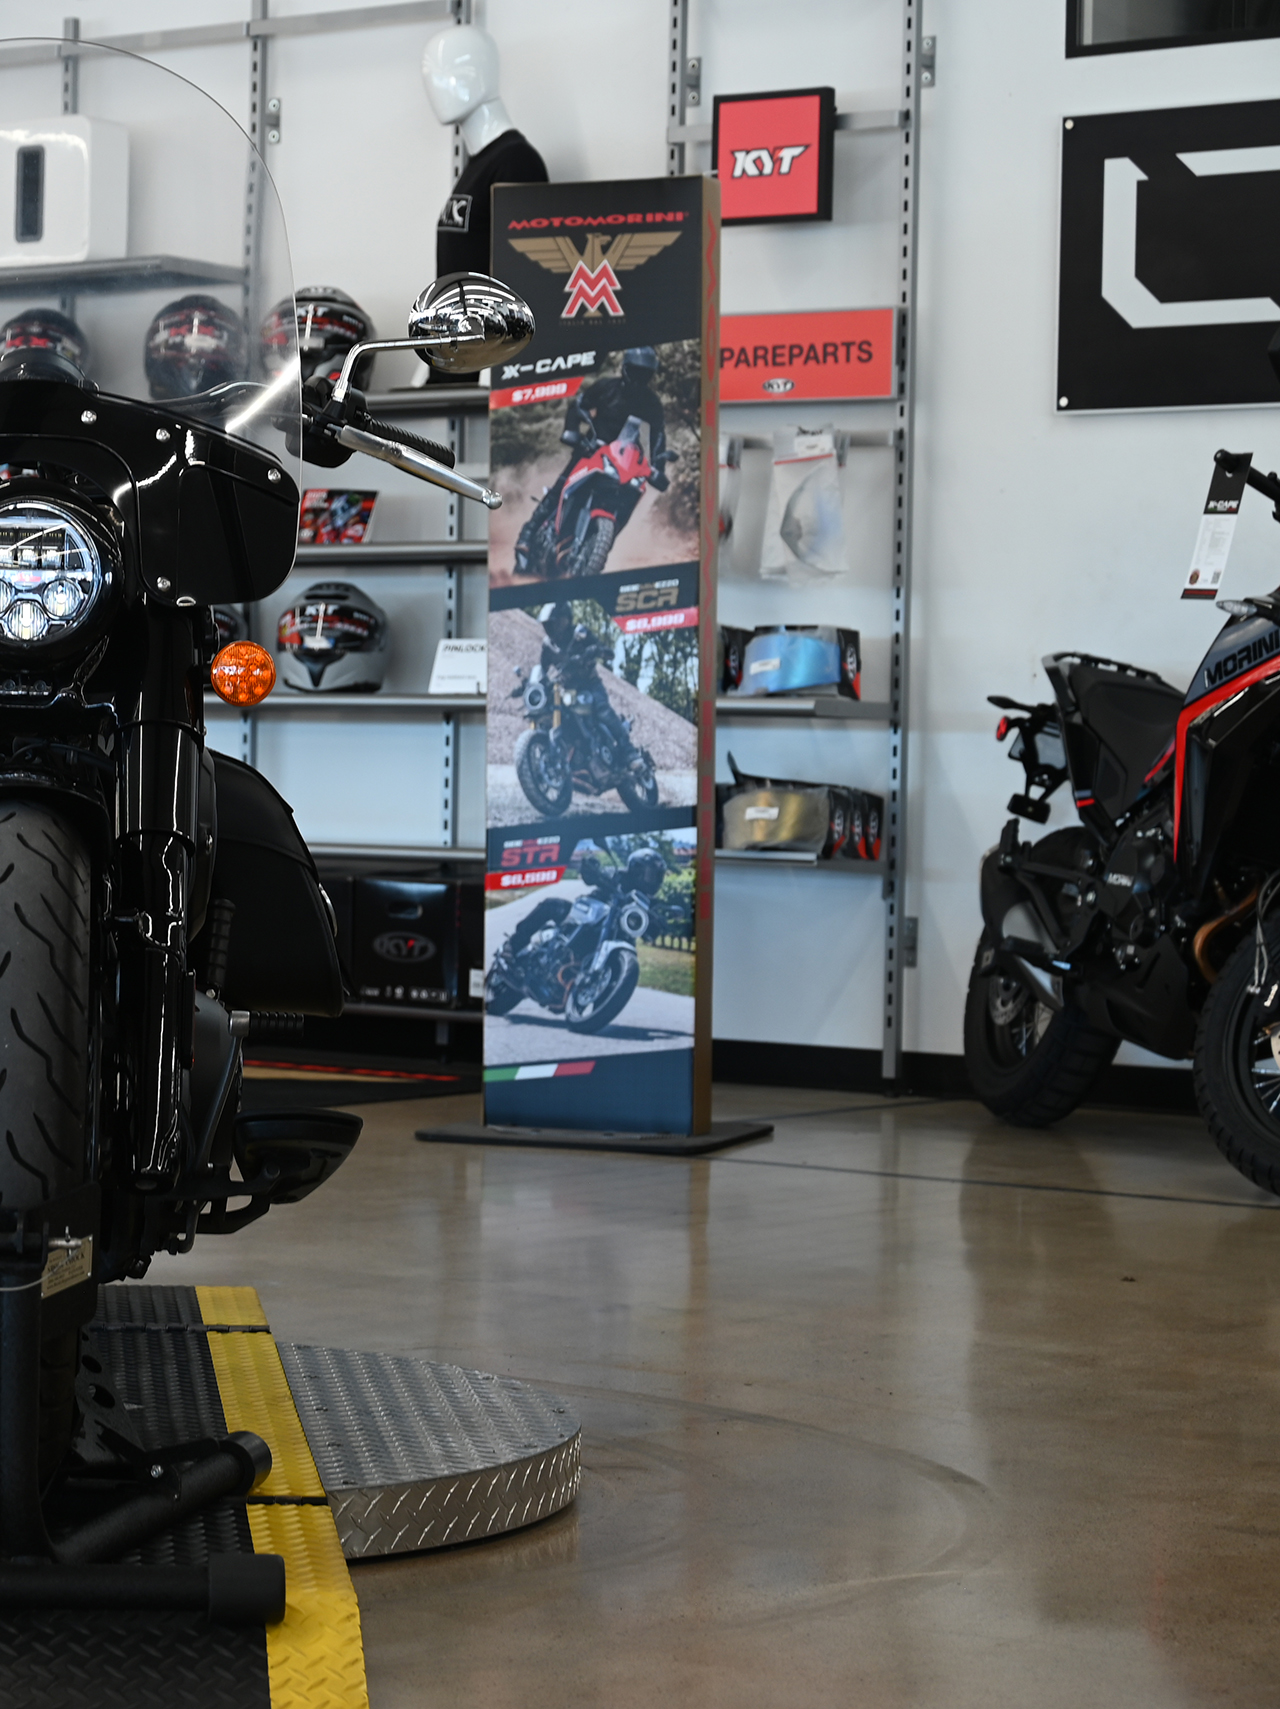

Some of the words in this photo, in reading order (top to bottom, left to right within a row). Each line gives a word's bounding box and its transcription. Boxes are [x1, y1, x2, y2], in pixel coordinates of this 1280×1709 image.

[730, 144, 811, 178] KYT
[501, 350, 596, 379] X-CAPE
[1204, 629, 1280, 689] MORINI
